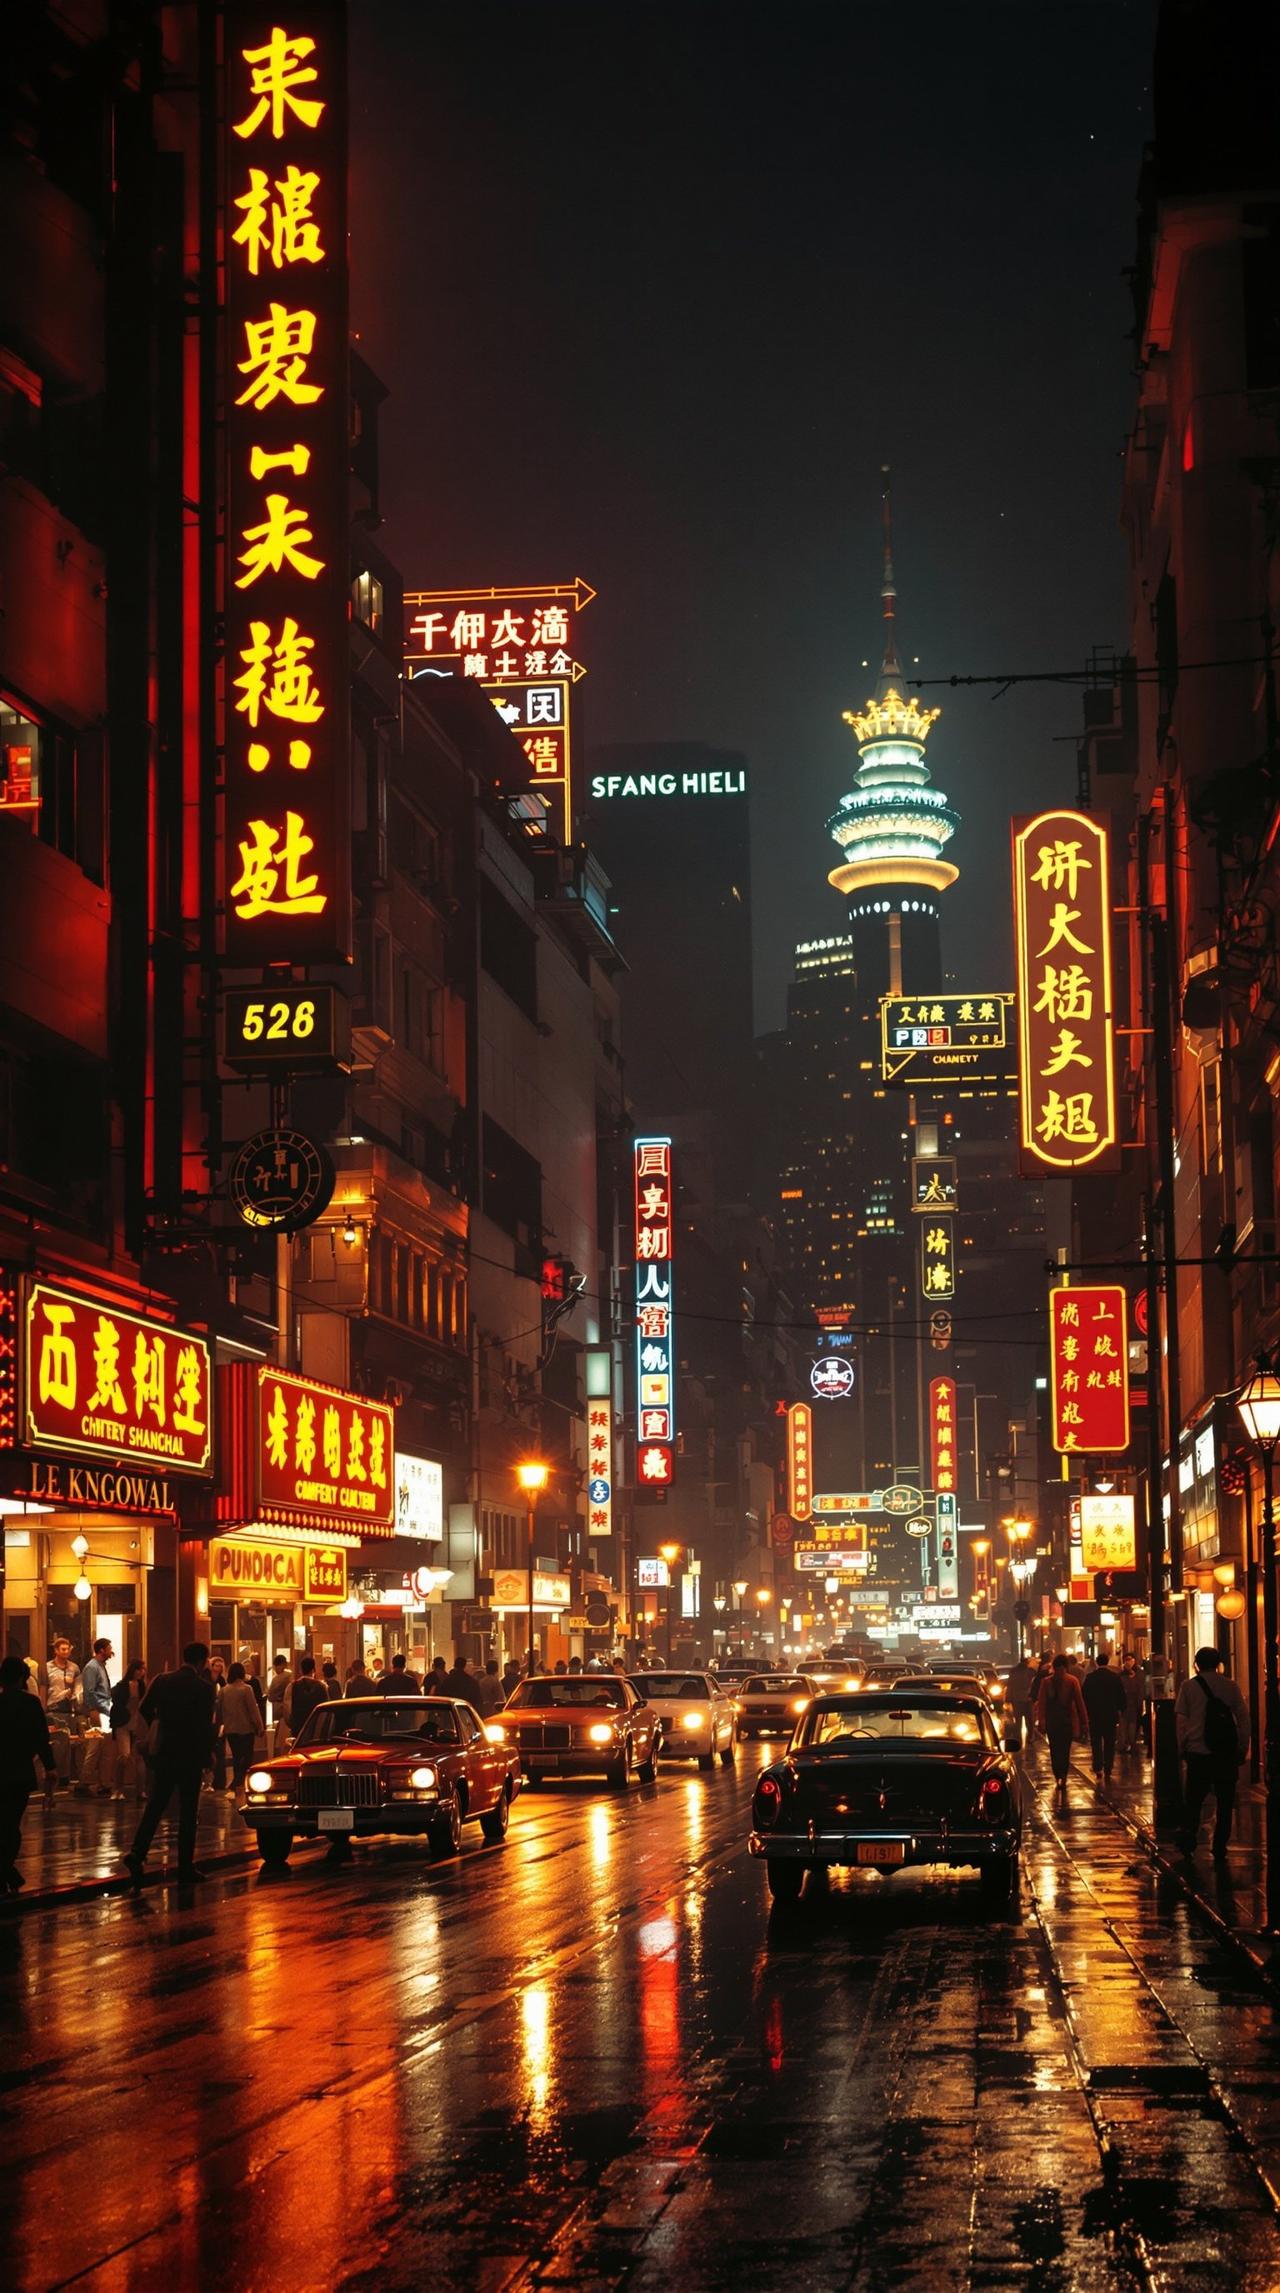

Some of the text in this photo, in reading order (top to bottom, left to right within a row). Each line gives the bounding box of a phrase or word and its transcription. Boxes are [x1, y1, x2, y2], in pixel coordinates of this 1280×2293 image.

[592, 771, 745, 798] SFANG HIELI
[31, 1462, 174, 1511] LE KNGOWAL
